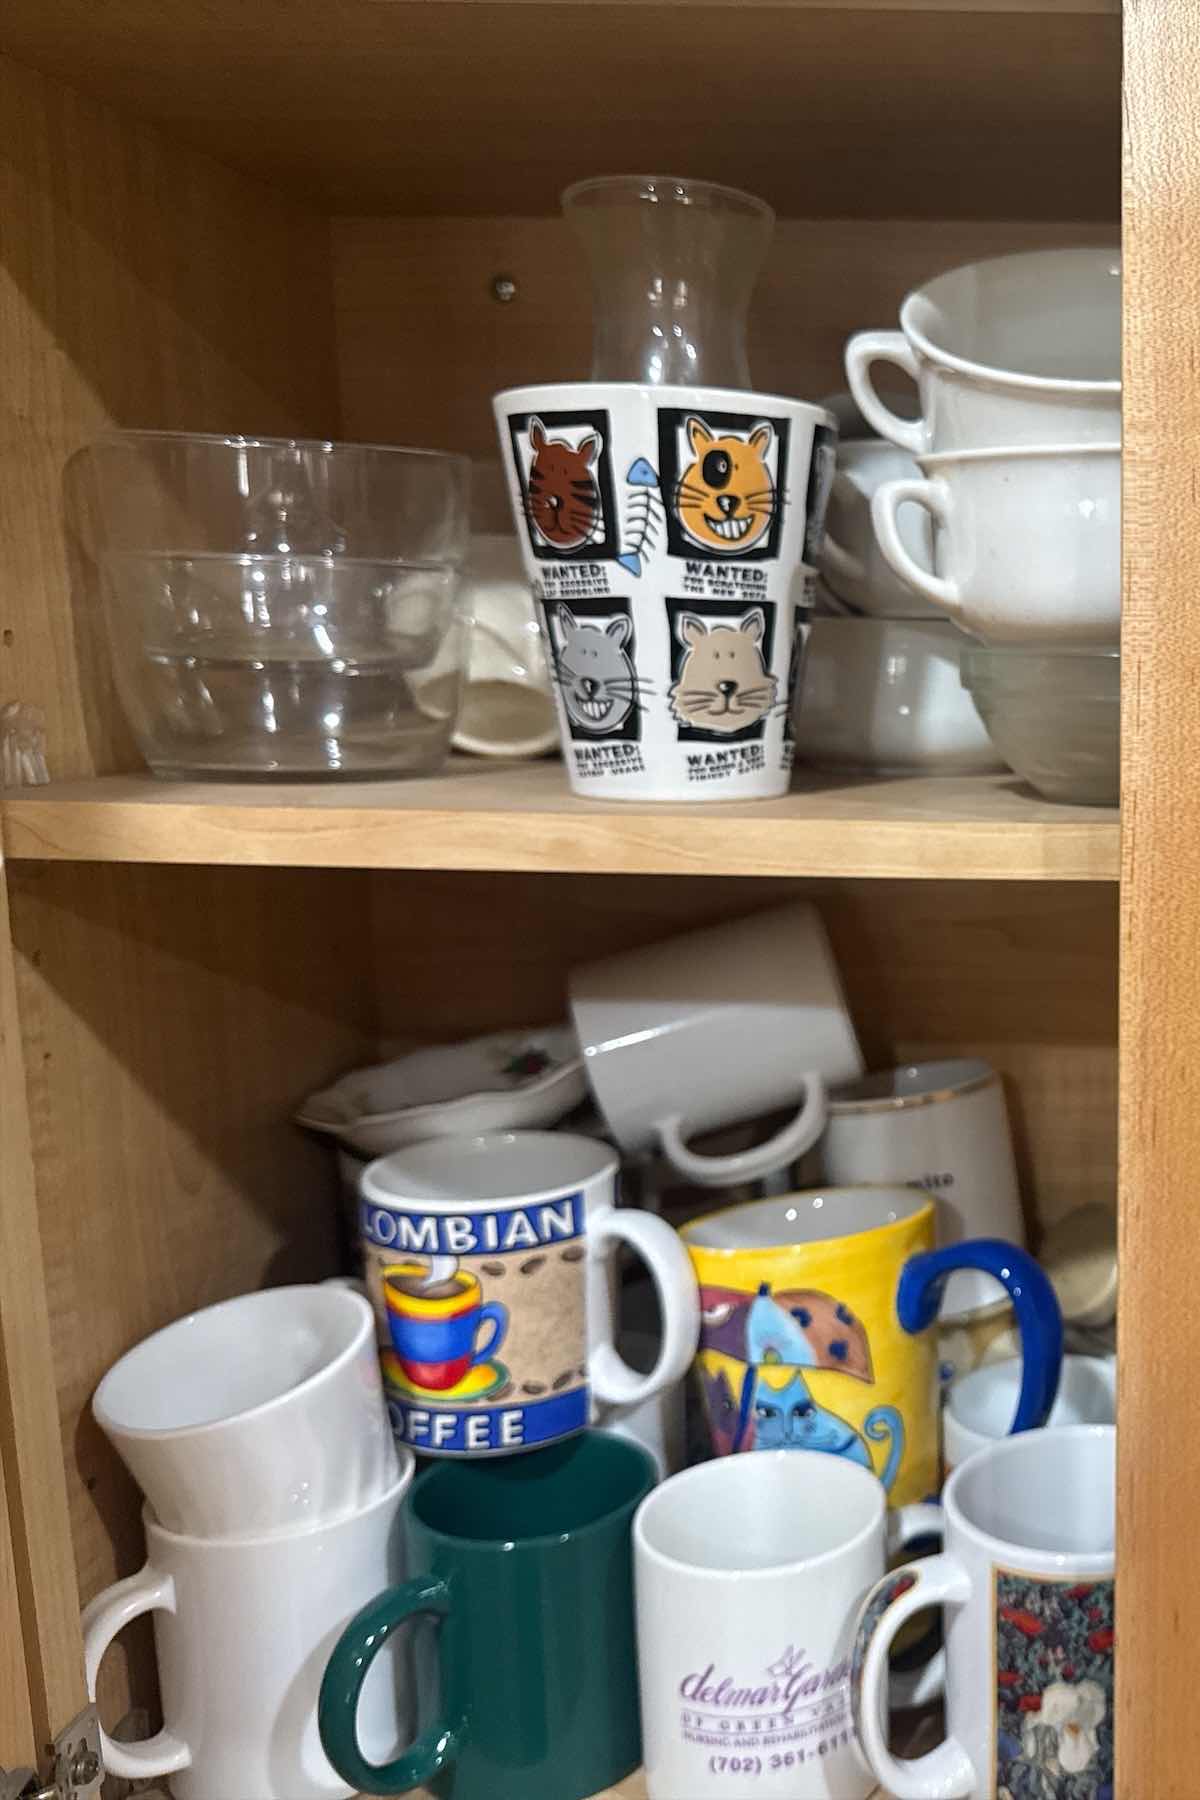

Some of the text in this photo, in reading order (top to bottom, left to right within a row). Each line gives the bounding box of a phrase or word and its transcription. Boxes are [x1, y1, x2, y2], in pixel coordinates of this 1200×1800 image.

[542, 564, 607, 579] WANTED:
[685, 561, 768, 583] WANTED:
[574, 744, 641, 760] WANTED:
[687, 744, 764, 766] WANTED:
[709, 1755, 762, 1776] (702)
